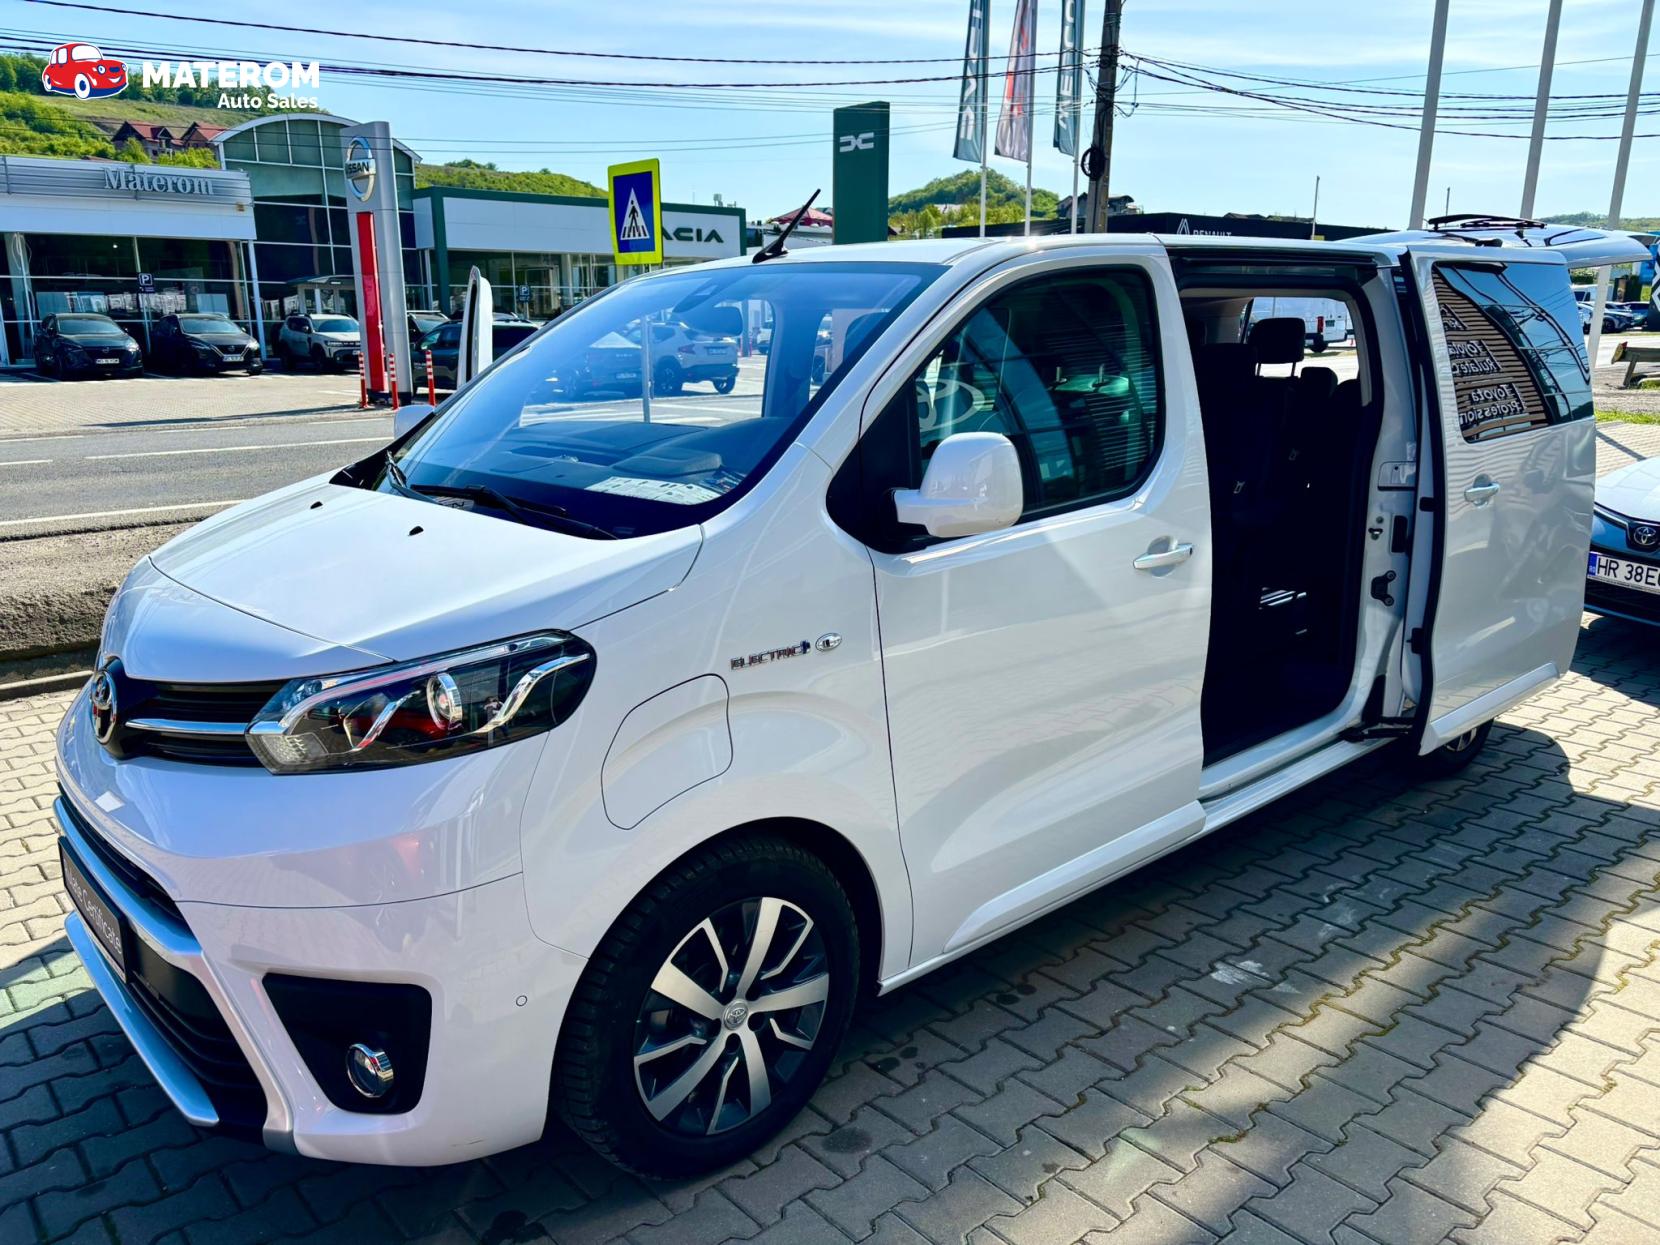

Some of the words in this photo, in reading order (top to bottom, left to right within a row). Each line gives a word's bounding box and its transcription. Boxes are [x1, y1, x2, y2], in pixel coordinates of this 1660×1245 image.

[102, 166, 215, 195] Materom
[1597, 557, 1619, 578] HR
[1624, 563, 1660, 587] 38E
[730, 644, 805, 671] ELECTRIC
